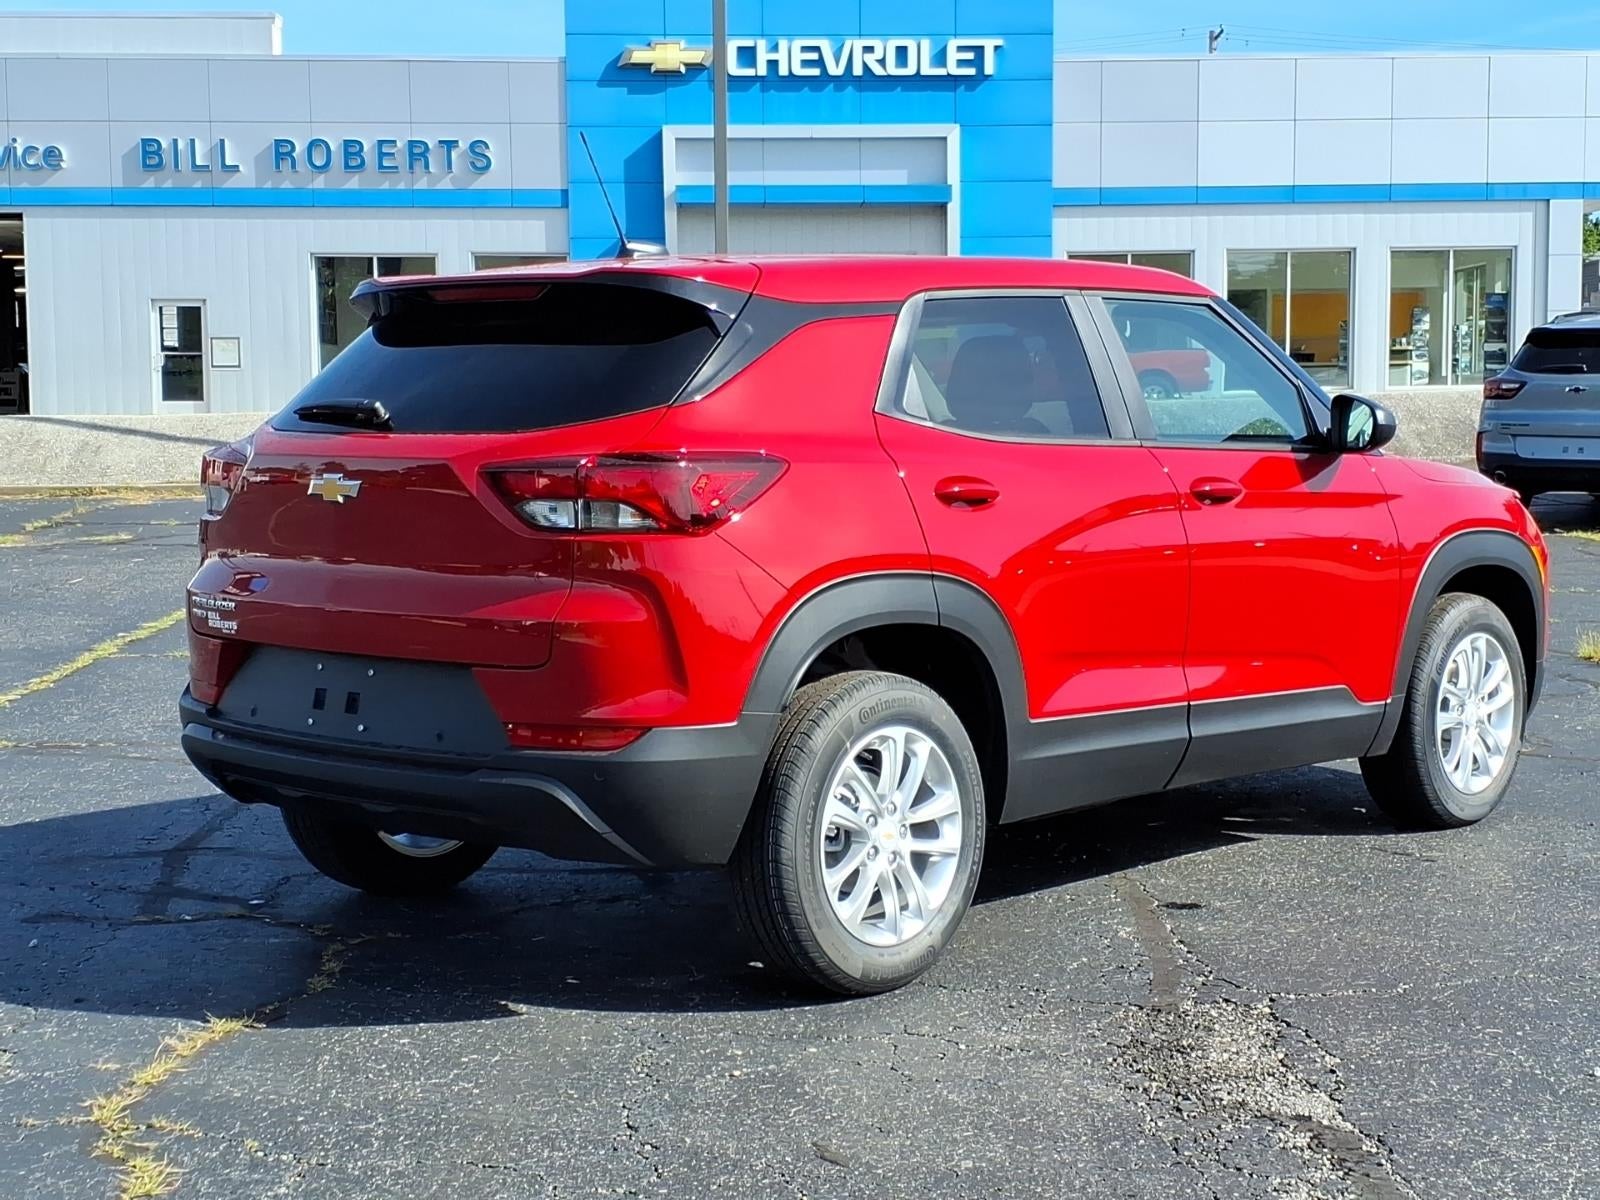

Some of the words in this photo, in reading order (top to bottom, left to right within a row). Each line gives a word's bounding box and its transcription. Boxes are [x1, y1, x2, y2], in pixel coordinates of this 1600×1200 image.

[726, 39, 1004, 76] CHEVROLET
[140, 137, 241, 172] BILL
[273, 137, 494, 173] ROBERTS
[859, 695, 917, 725] Continental
